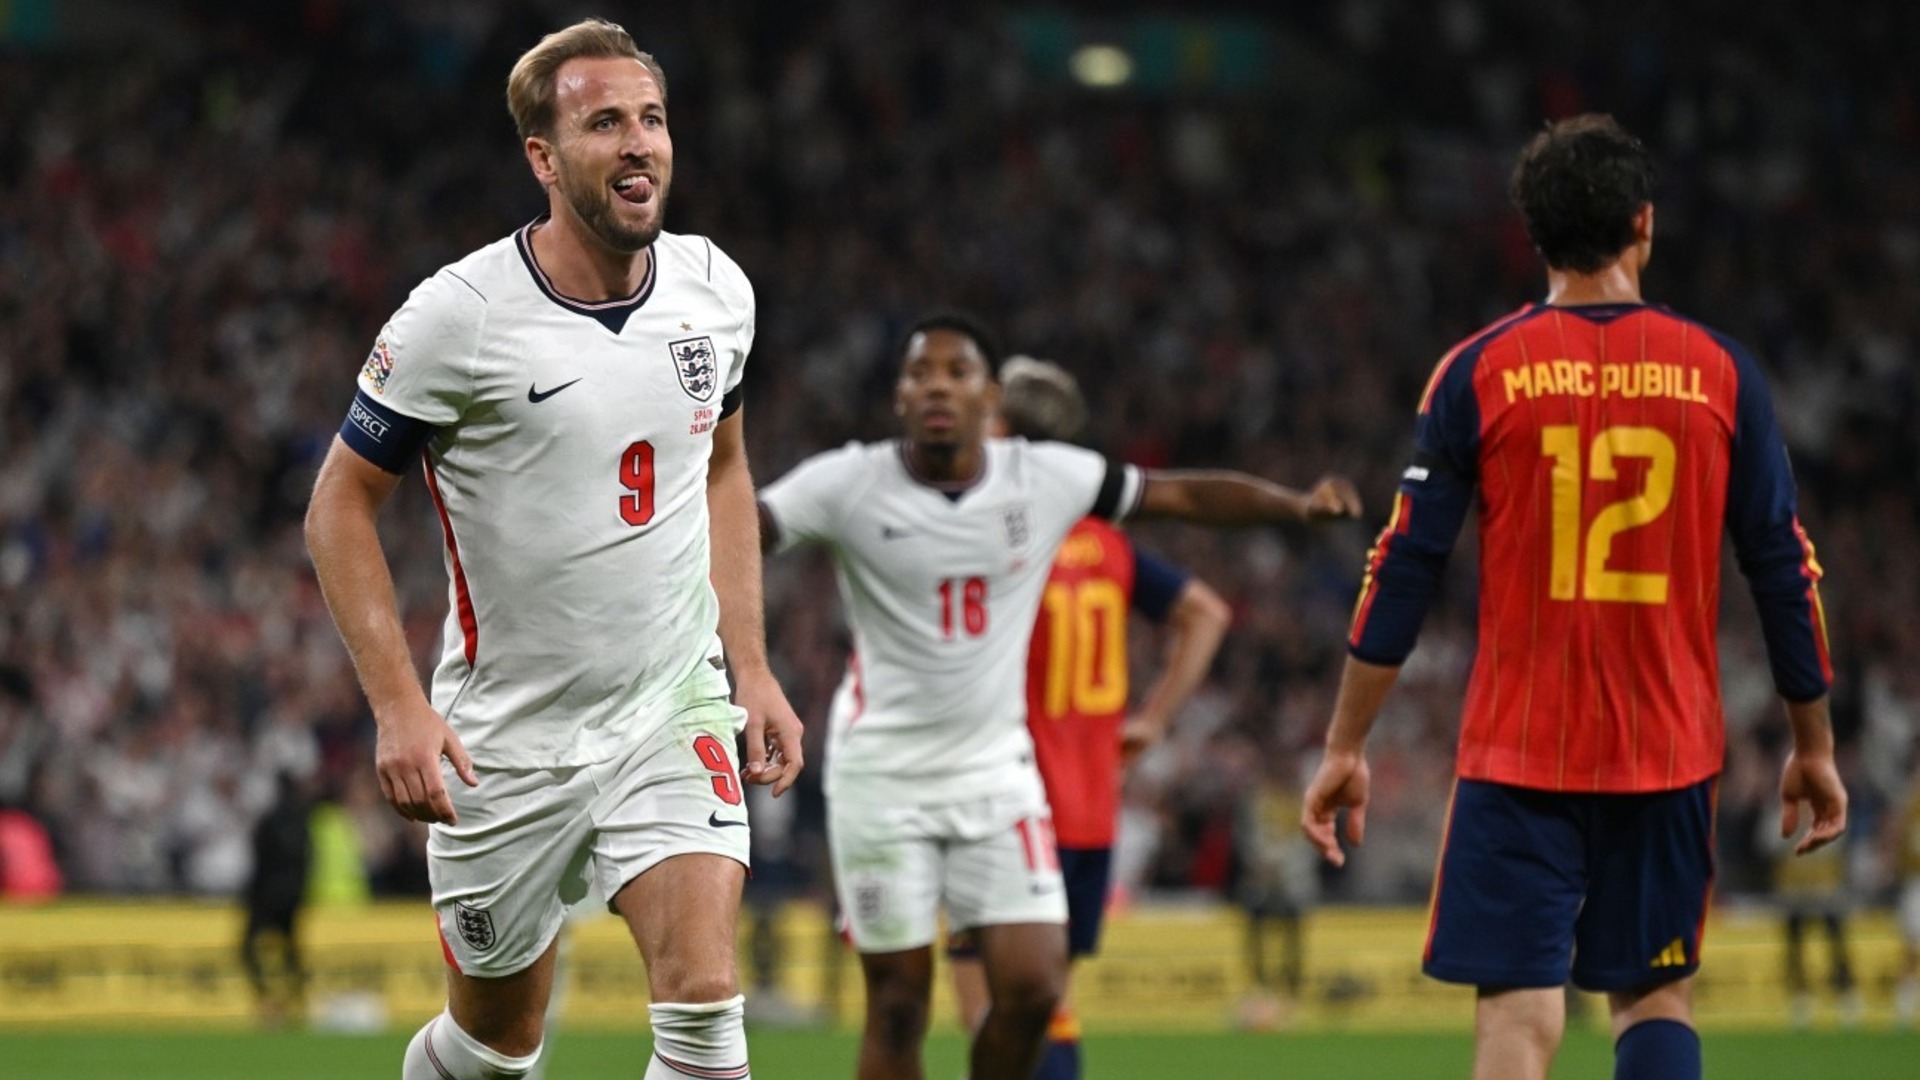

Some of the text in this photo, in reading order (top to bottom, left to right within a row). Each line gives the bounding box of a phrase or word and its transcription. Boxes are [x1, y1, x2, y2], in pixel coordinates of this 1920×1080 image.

[1502, 360, 1709, 404] MARC PUBILL
[619, 440, 655, 527] 9
[1542, 425, 1677, 604] 12
[1045, 578, 1129, 719] 10
[692, 735, 742, 807] 9
